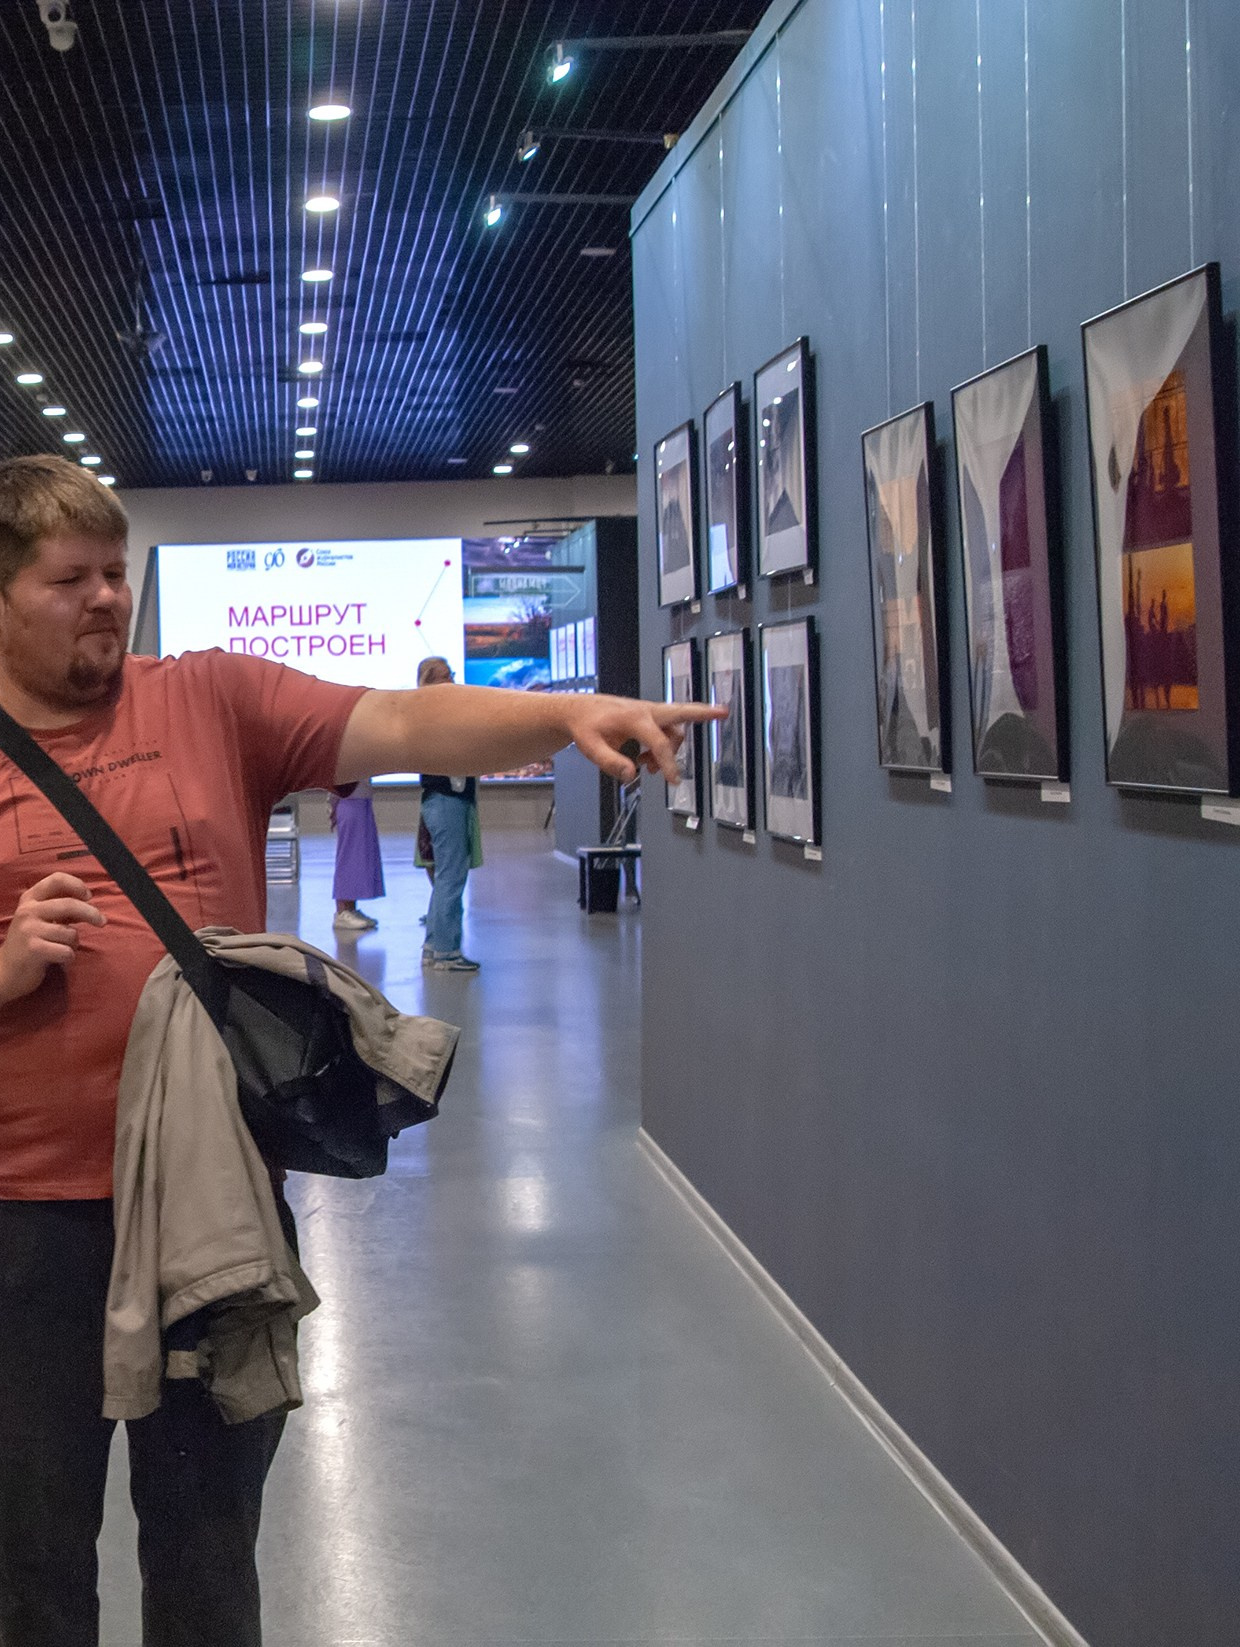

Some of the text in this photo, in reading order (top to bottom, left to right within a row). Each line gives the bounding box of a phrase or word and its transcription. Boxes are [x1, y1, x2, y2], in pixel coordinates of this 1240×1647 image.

[228, 603, 367, 627] МАРШРУТ
[230, 634, 386, 657] ПОСТРОЕН
[72, 750, 163, 784] OWN DWELLER
